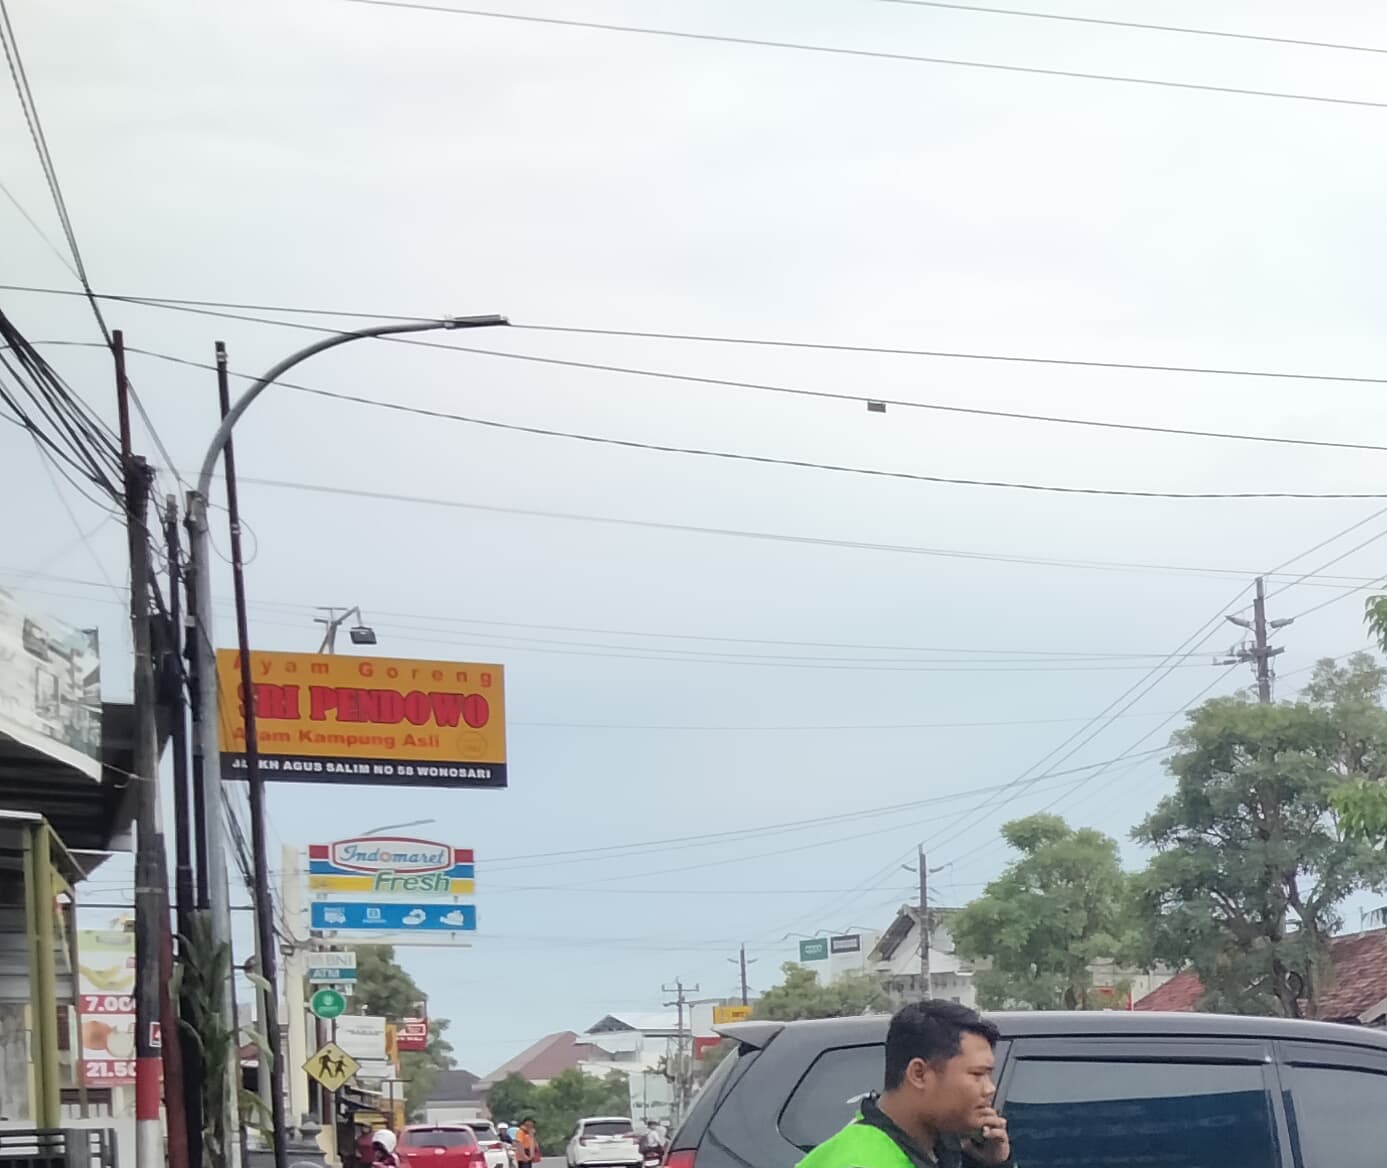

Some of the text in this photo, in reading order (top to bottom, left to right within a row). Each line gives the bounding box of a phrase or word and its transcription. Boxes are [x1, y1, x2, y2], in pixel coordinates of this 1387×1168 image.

[358, 661, 493, 688] Goreng
[309, 685, 490, 729] PENDOWO
[232, 726, 291, 743] Aam
[299, 728, 396, 749] Kampung
[403, 732, 440, 749] Asli
[258, 760, 281, 770] KH
[283, 760, 324, 772] AGUS
[326, 762, 371, 774] SALIM
[374, 764, 394, 775] NO
[417, 766, 491, 779] WONOSARI
[339, 845, 445, 865] Indomaret
[374, 872, 451, 892] Fresh
[312, 968, 341, 978] ATM
[85, 995, 136, 1012] 7.00
